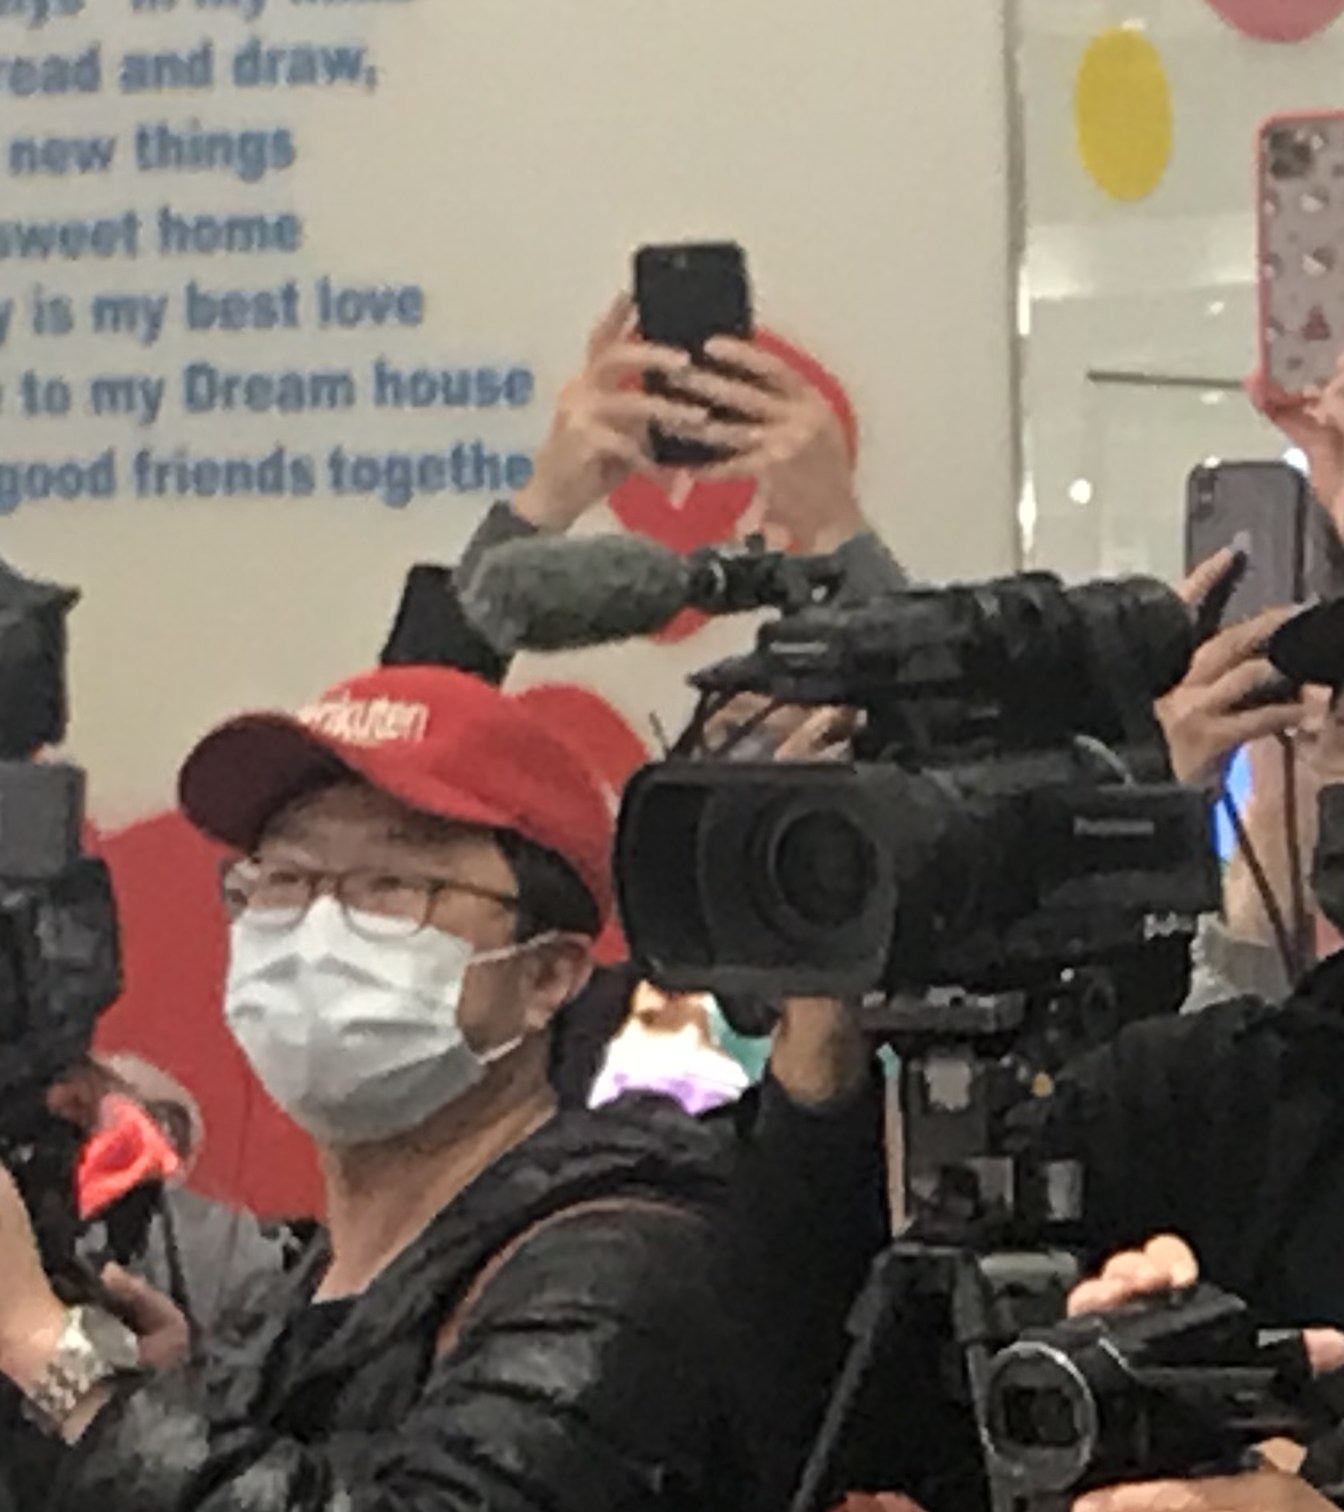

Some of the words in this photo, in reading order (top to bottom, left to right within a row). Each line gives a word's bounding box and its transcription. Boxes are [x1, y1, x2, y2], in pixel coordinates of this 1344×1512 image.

[119, 42, 213, 93] and
[232, 38, 377, 92] draw,
[8, 136, 116, 176] new
[134, 121, 296, 182] things
[157, 205, 302, 255] home
[31, 284, 74, 336] is
[90, 295, 168, 346] my
[184, 280, 300, 331] best
[315, 276, 424, 330] love
[20, 370, 72, 417] to
[90, 376, 165, 426] my
[181, 362, 356, 413] Dream
[373, 358, 534, 408] house
[0, 446, 117, 516] good
[133, 443, 315, 500] friends
